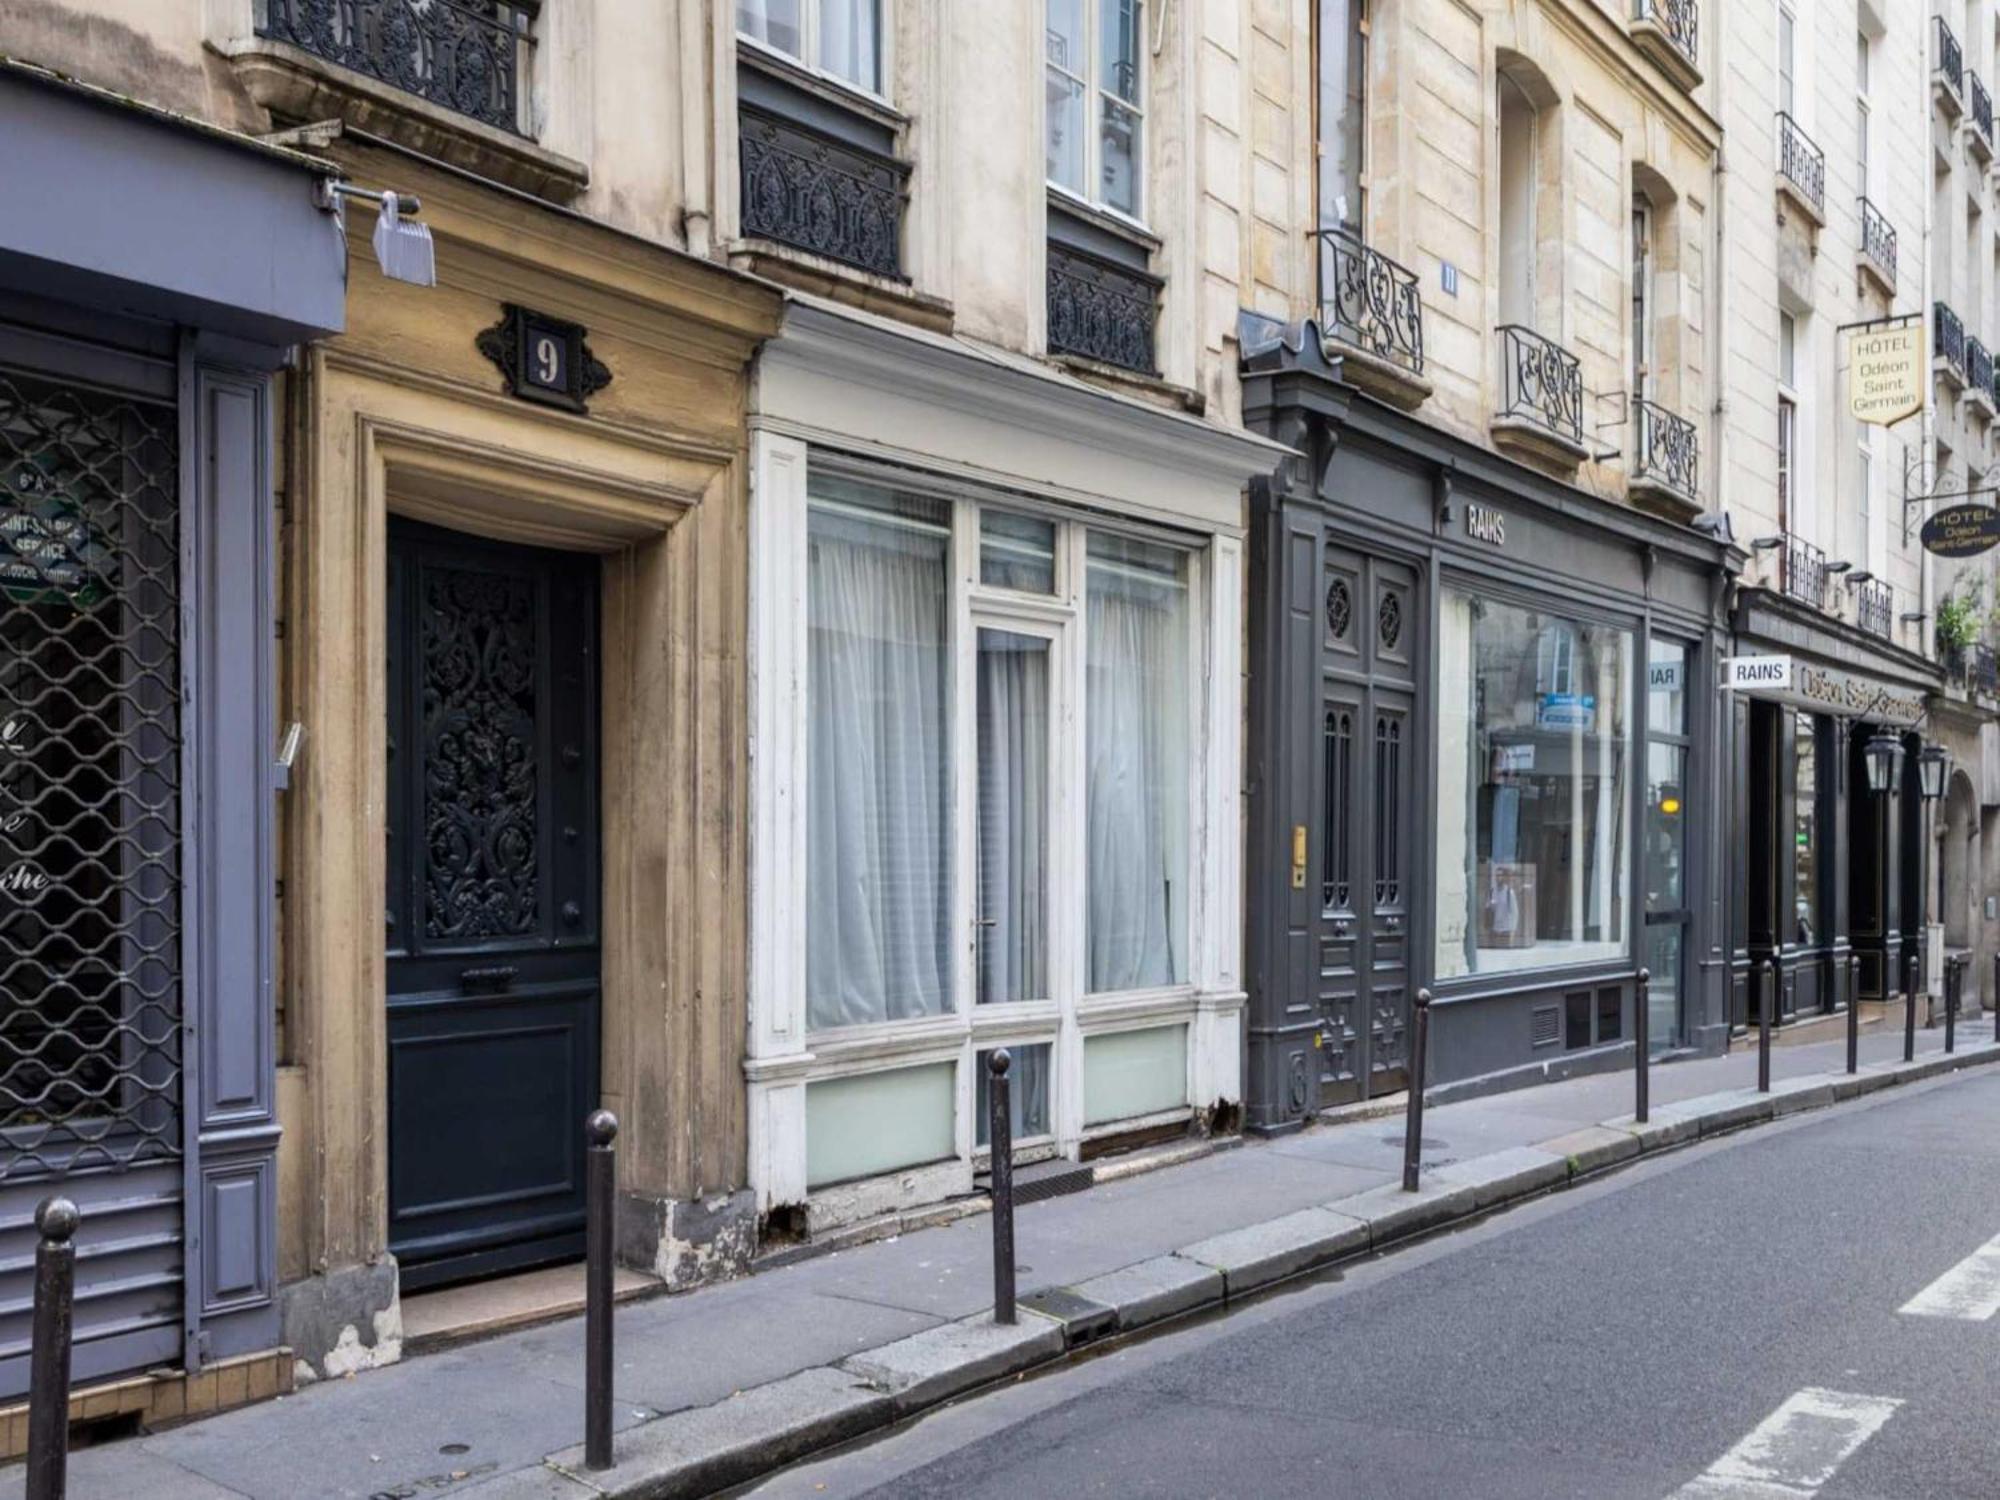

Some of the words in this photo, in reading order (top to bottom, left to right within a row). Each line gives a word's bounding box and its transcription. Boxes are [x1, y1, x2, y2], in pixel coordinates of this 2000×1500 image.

[1858, 336, 1912, 356] HÔTEL
[537, 338, 558, 383] 9
[1860, 361, 1909, 377] Odéon
[1864, 379, 1904, 394] Saint
[1854, 394, 1916, 411] Germain
[1468, 504, 1505, 545] RAINS
[1736, 663, 1783, 681] RAINS
